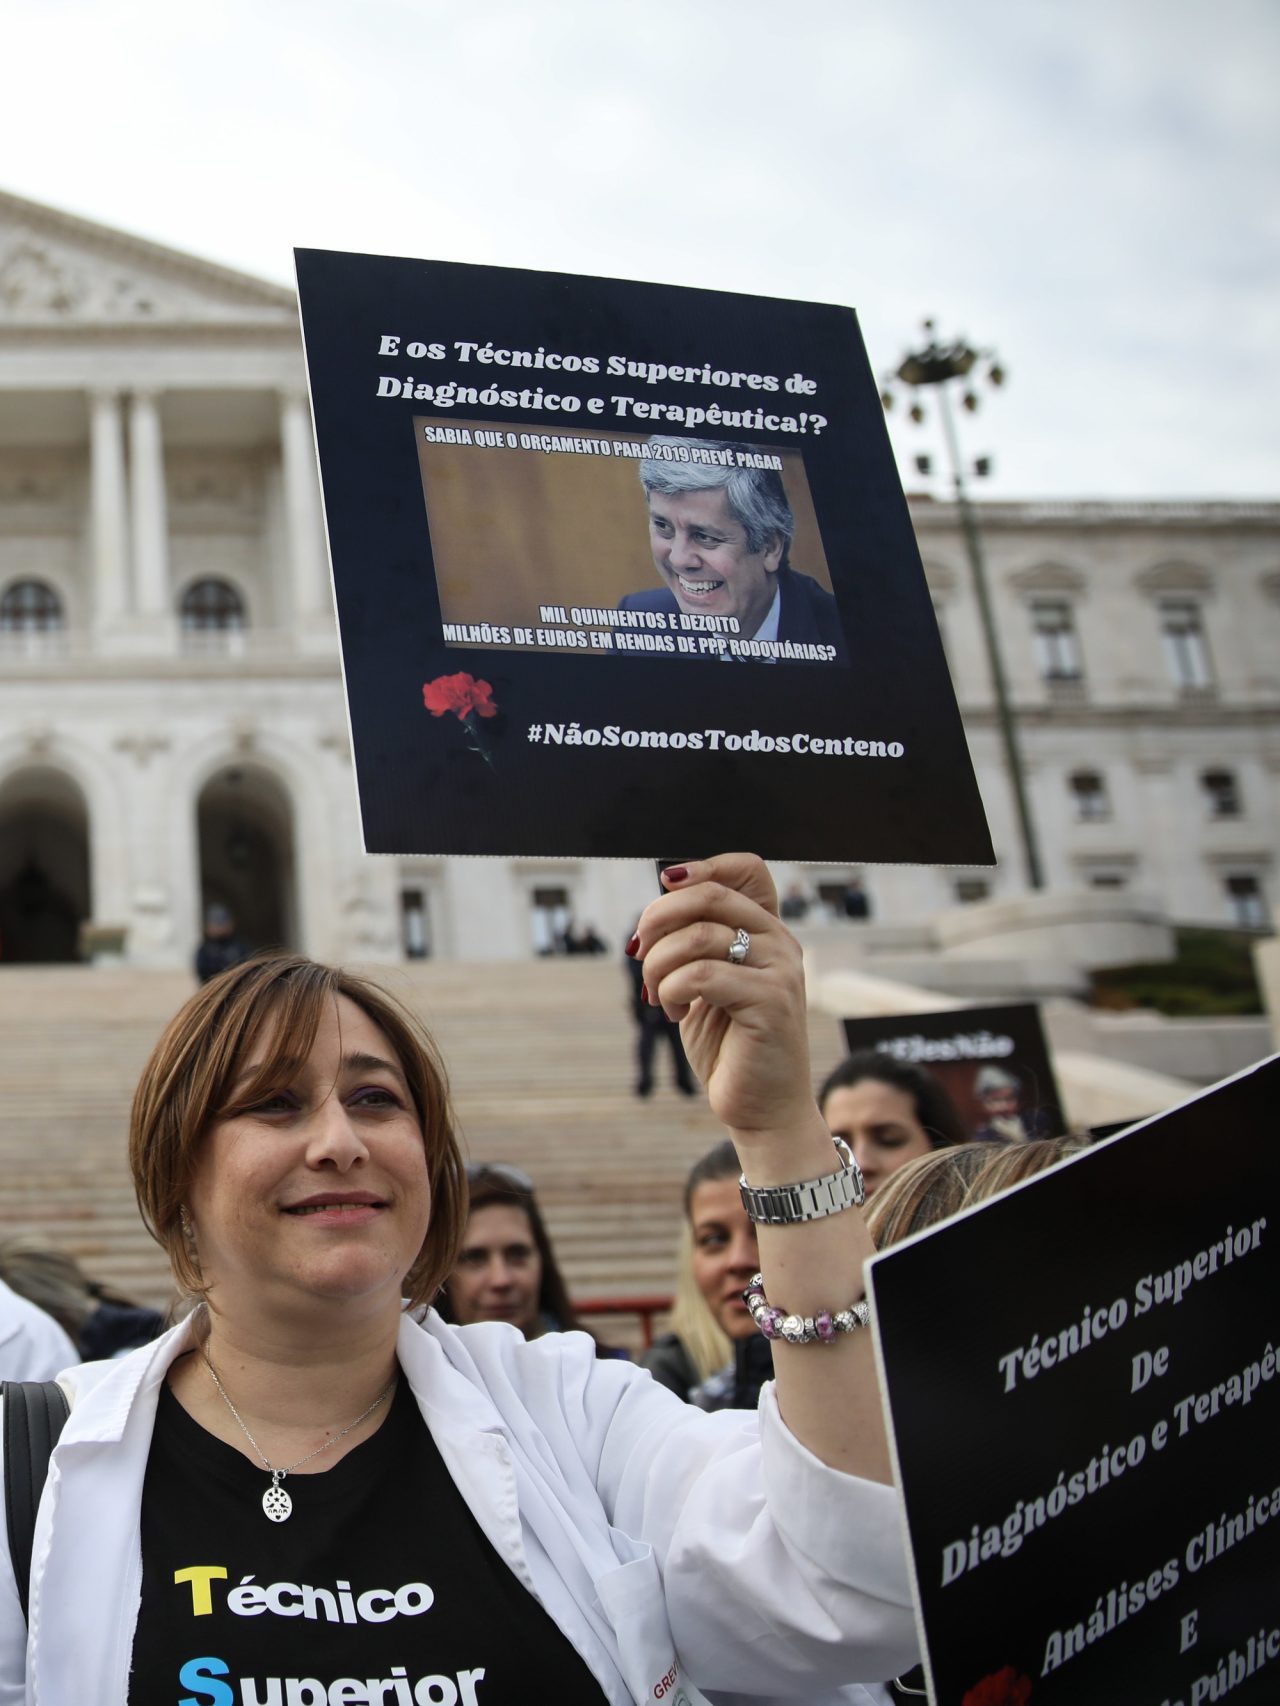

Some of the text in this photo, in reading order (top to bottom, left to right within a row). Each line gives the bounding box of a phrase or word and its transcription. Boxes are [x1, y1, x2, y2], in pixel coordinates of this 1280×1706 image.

[378, 335, 817, 395] E os Técnicos Superiores de
[376, 377, 827, 435] Diagnóstico e Terapêutica!?
[425, 426, 783, 471] SABIA QUE O ORÇAMENTO PARA 2019 PREVÊ PAGAR
[442, 622, 837, 661] MILHÕES DE EUROS EM RENDAS DE PPP RODOVIÁRIAS?
[539, 606, 740, 633] MIL QUINHENTOS E DEZOITO
[527, 722, 904, 757] #NãoSomosTodosCenteno
[999, 1218, 1266, 1393] Técnico Superior
[1131, 1346, 1169, 1393] De
[941, 1342, 1280, 1586] Diagnóstico e Terapê
[174, 1566, 434, 1624] Técnico
[1041, 1559, 1179, 1677] Análises
[1180, 1609, 1198, 1653] E
[179, 1657, 485, 1706] Superior
